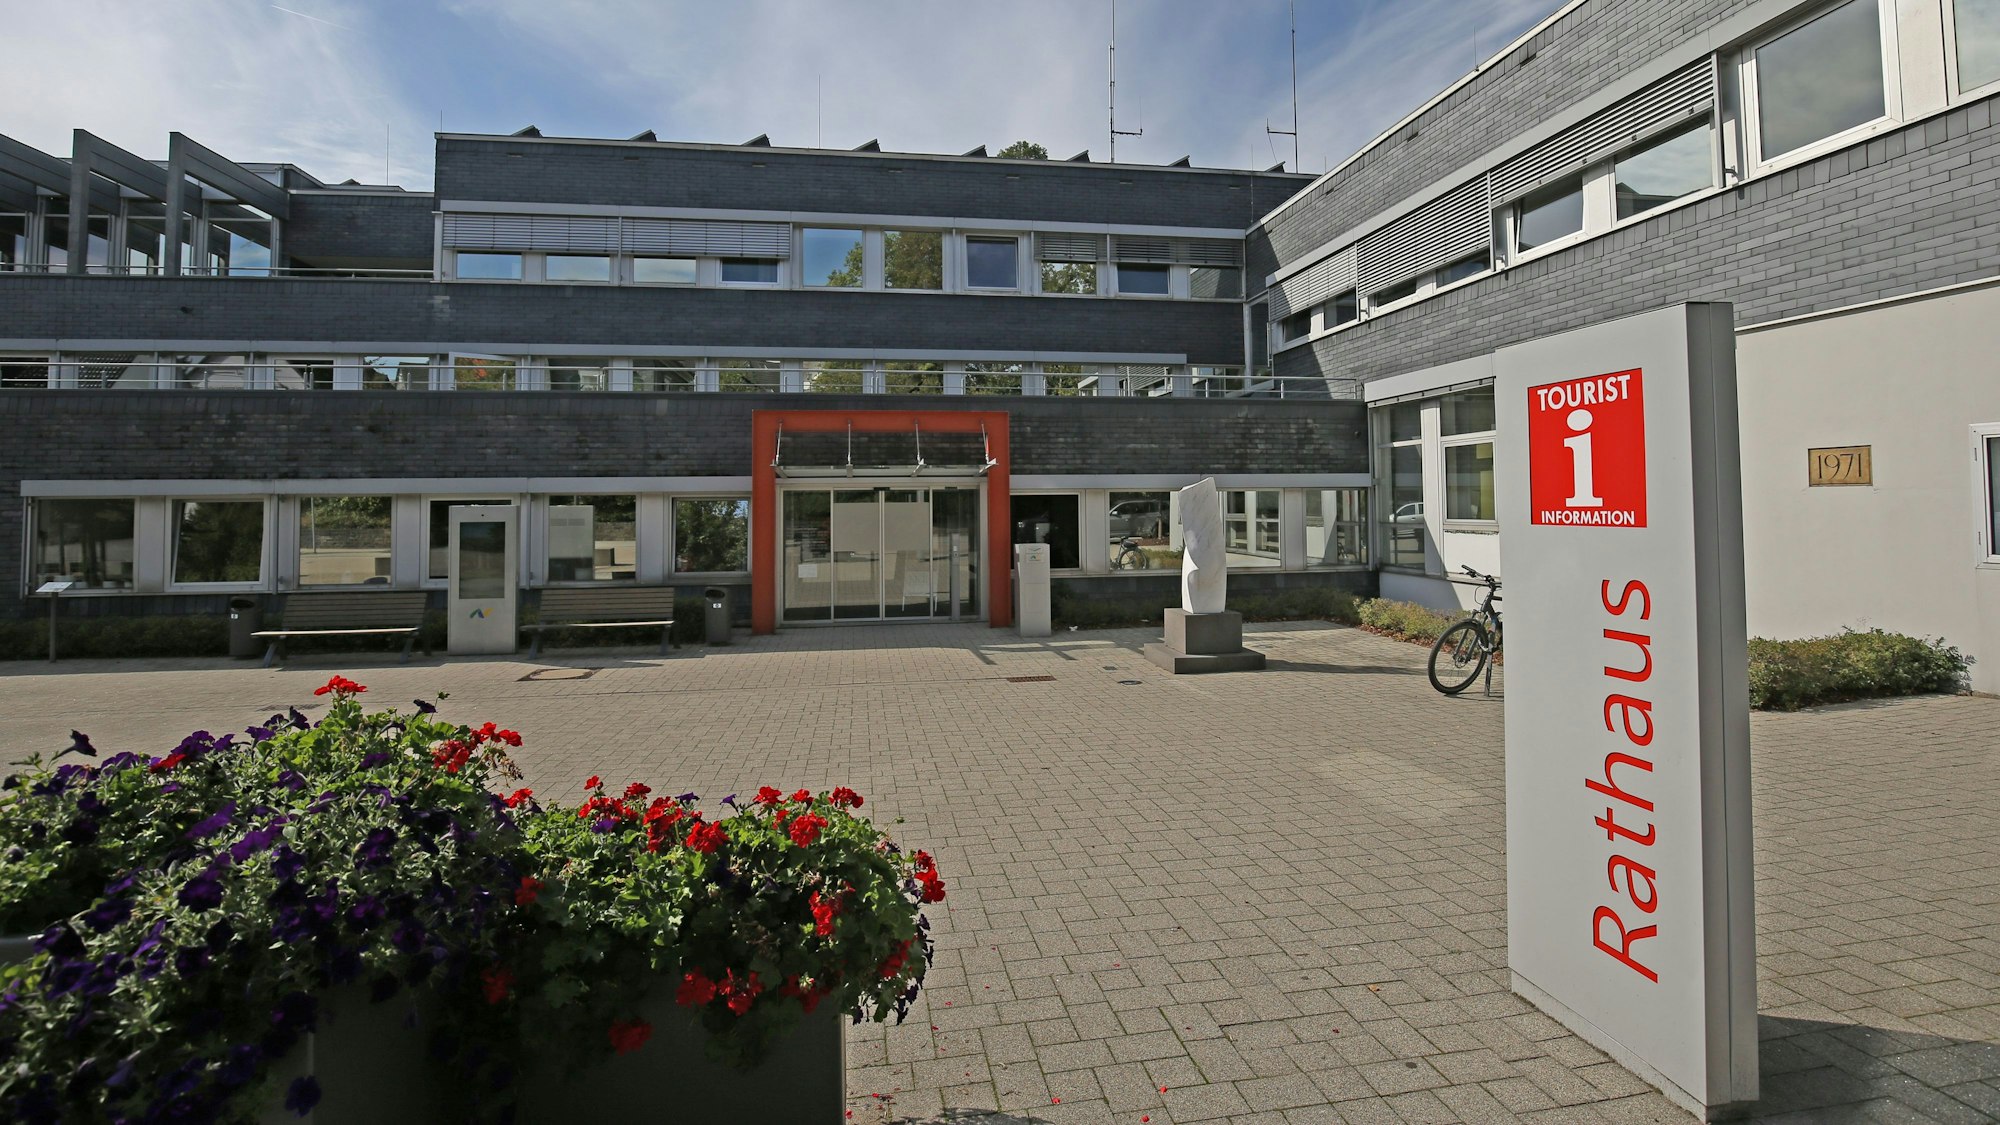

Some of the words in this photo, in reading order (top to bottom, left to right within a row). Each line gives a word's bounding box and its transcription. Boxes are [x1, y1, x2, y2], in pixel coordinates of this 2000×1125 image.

[1537, 374, 1631, 412] TOURIST
[1817, 453, 1862, 481] 1971
[1541, 510, 1635, 526] INFORMATION
[1585, 579, 1659, 984] Rathaus
